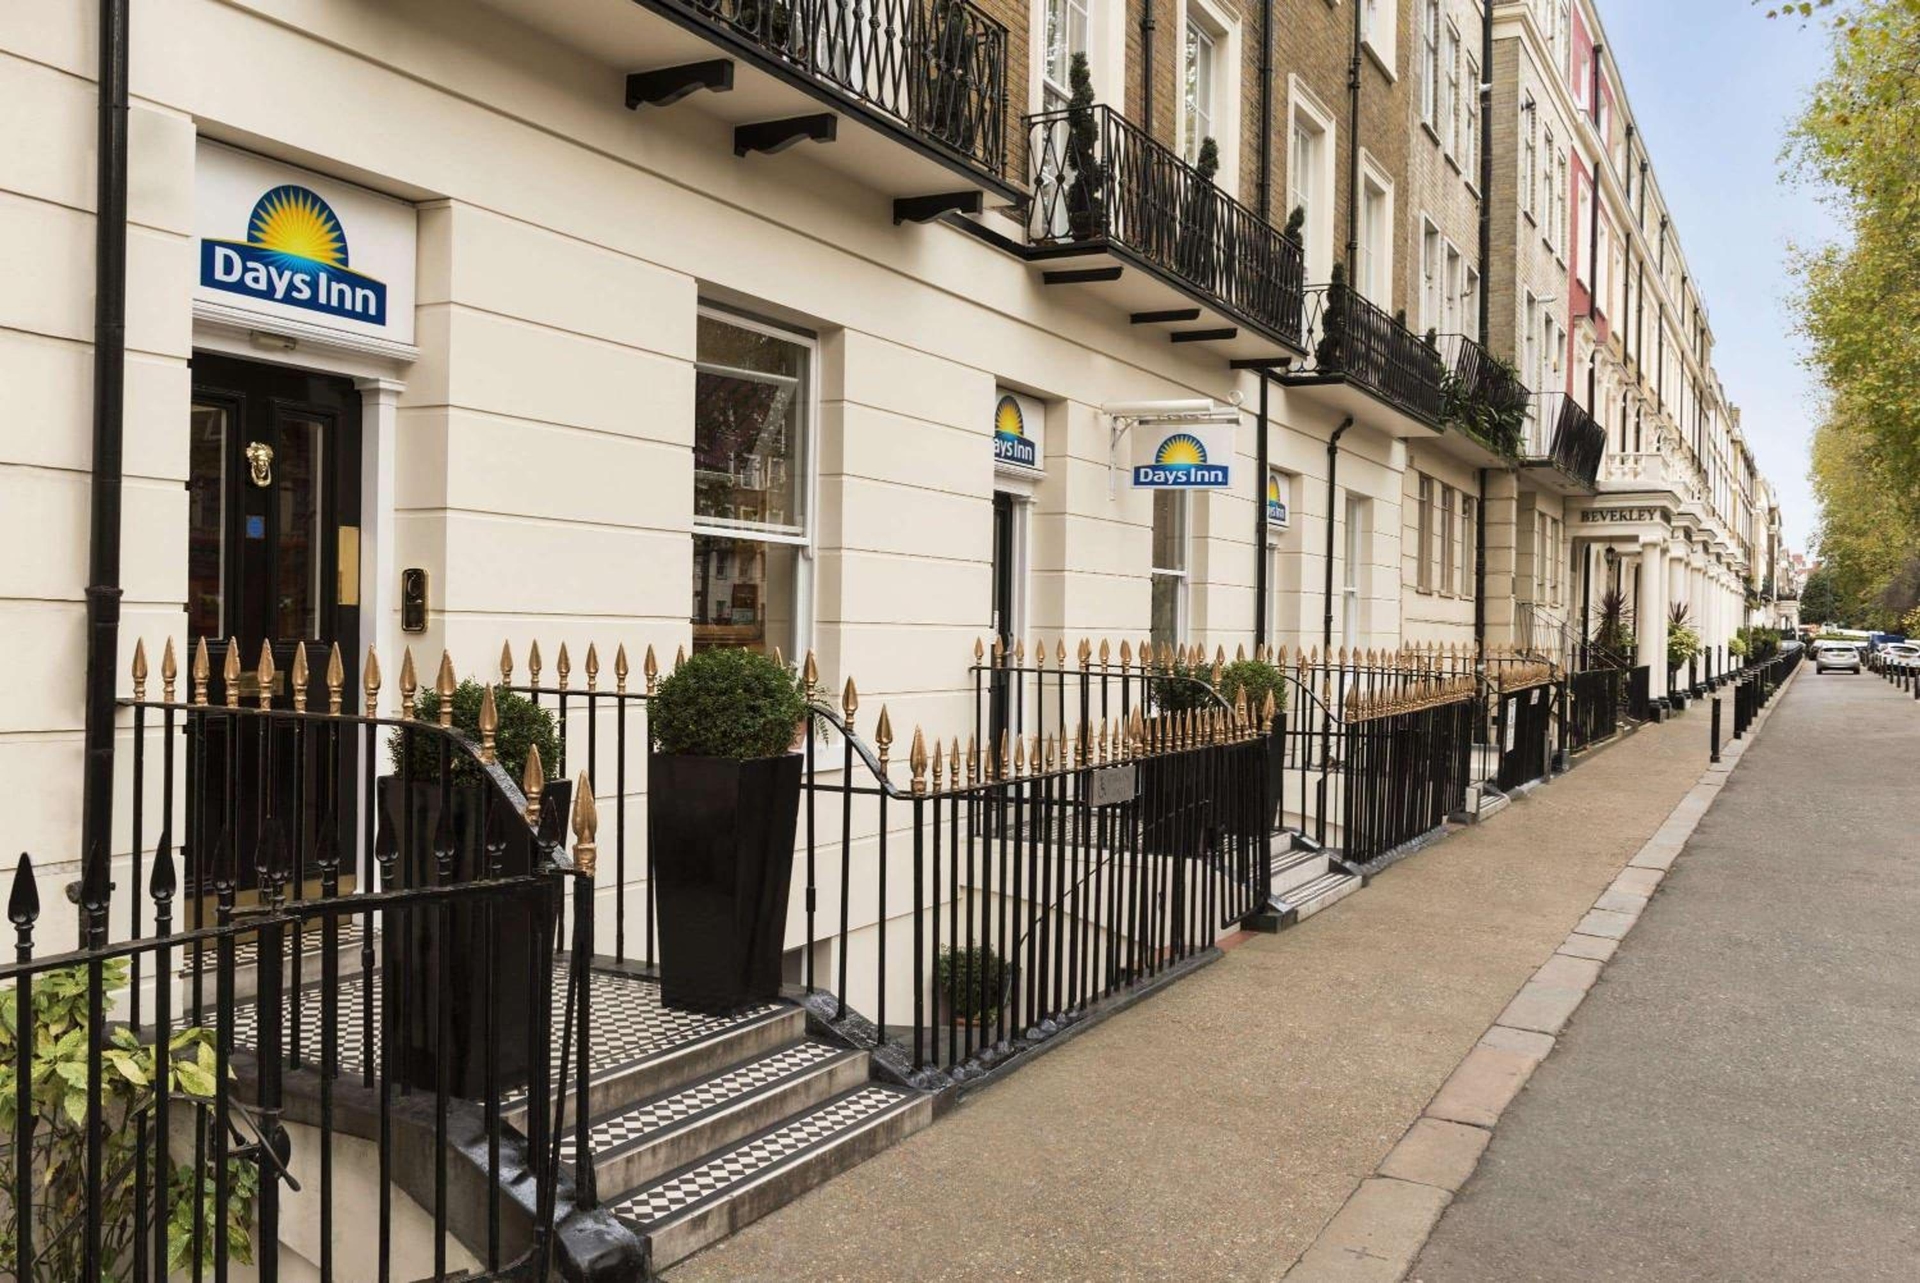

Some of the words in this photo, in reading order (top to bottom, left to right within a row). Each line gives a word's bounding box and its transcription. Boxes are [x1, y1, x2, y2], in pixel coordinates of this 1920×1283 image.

[214, 245, 312, 300] Days
[318, 271, 377, 316] Inn
[994, 438, 1013, 457] ays
[1014, 439, 1033, 461] Inn
[1139, 467, 1188, 485] Days
[1189, 467, 1223, 483] Inn
[1580, 508, 1657, 523] BEVERLEY
